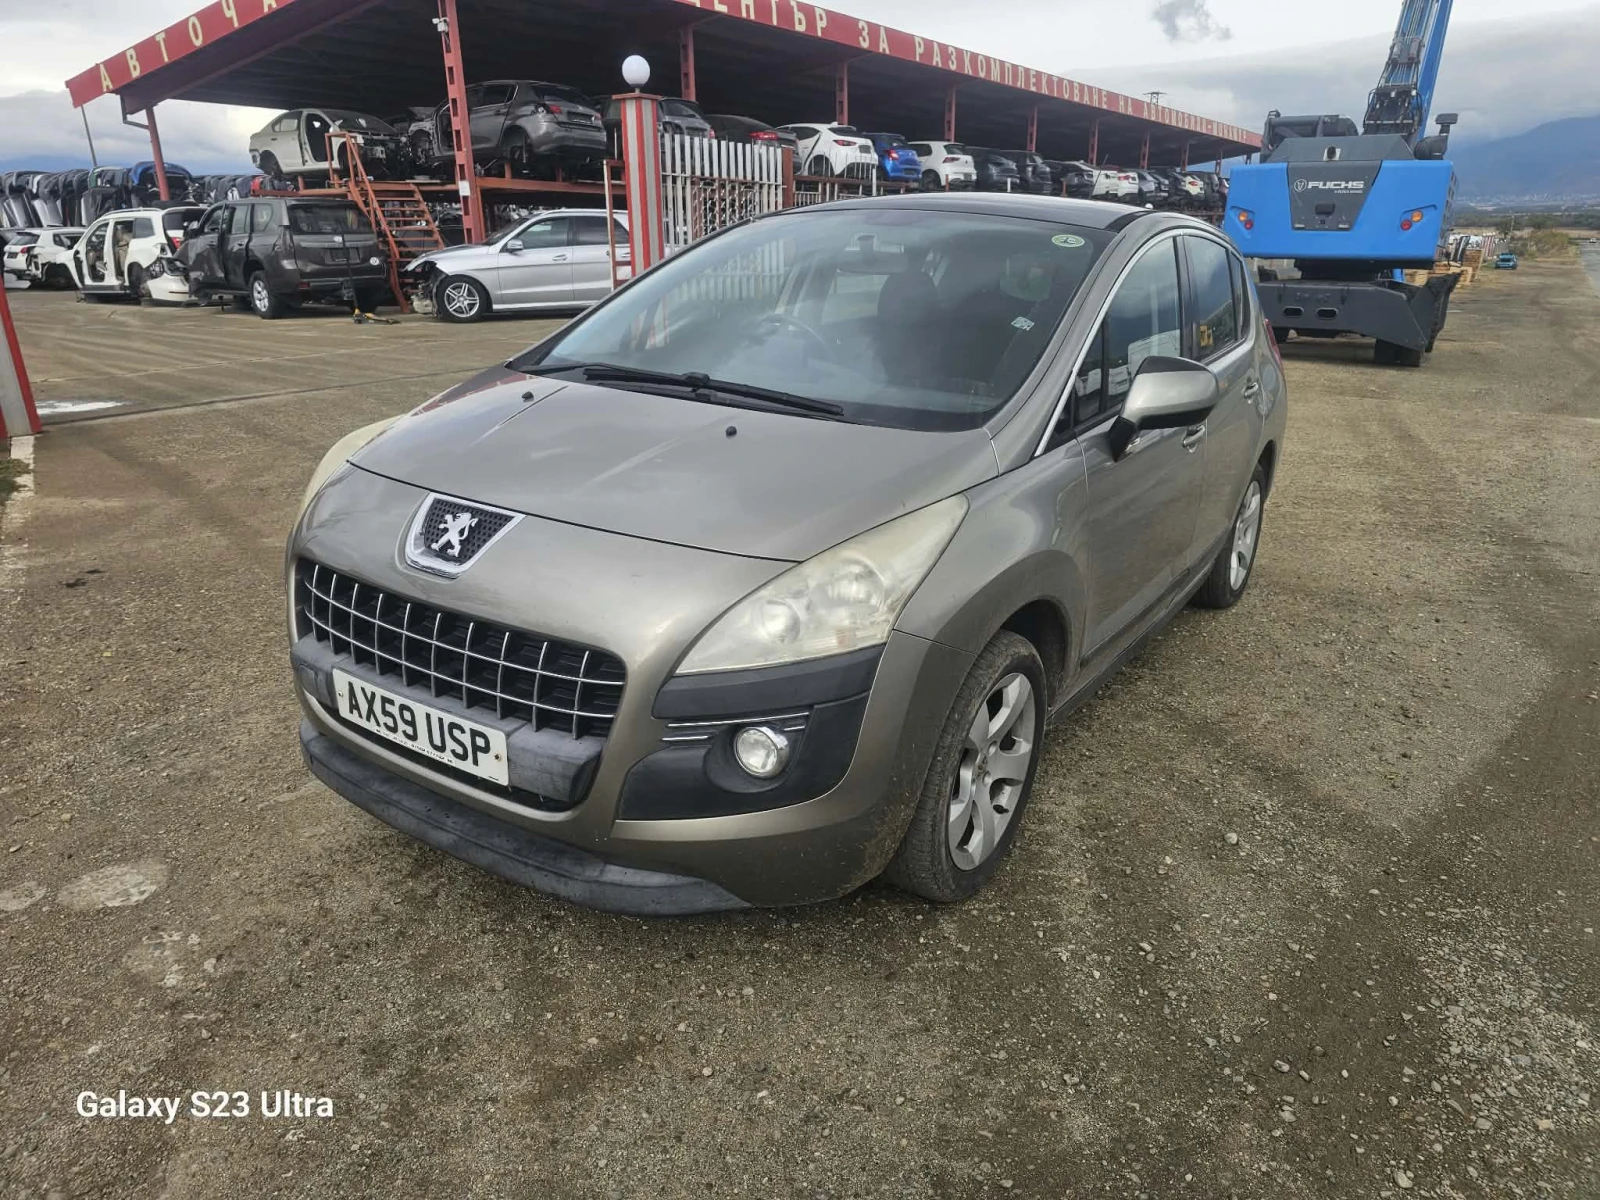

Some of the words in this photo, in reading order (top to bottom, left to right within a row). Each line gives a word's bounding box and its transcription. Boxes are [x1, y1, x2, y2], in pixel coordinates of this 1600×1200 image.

[858, 20, 891, 54] ЗА
[913, 35, 1108, 109] РАЗКОМПЛЕКТОВАНЕ
[1118, 93, 1133, 116] НА
[1307, 181, 1364, 189] FUCHS
[347, 680, 418, 742] AX59
[425, 711, 491, 767] USP
